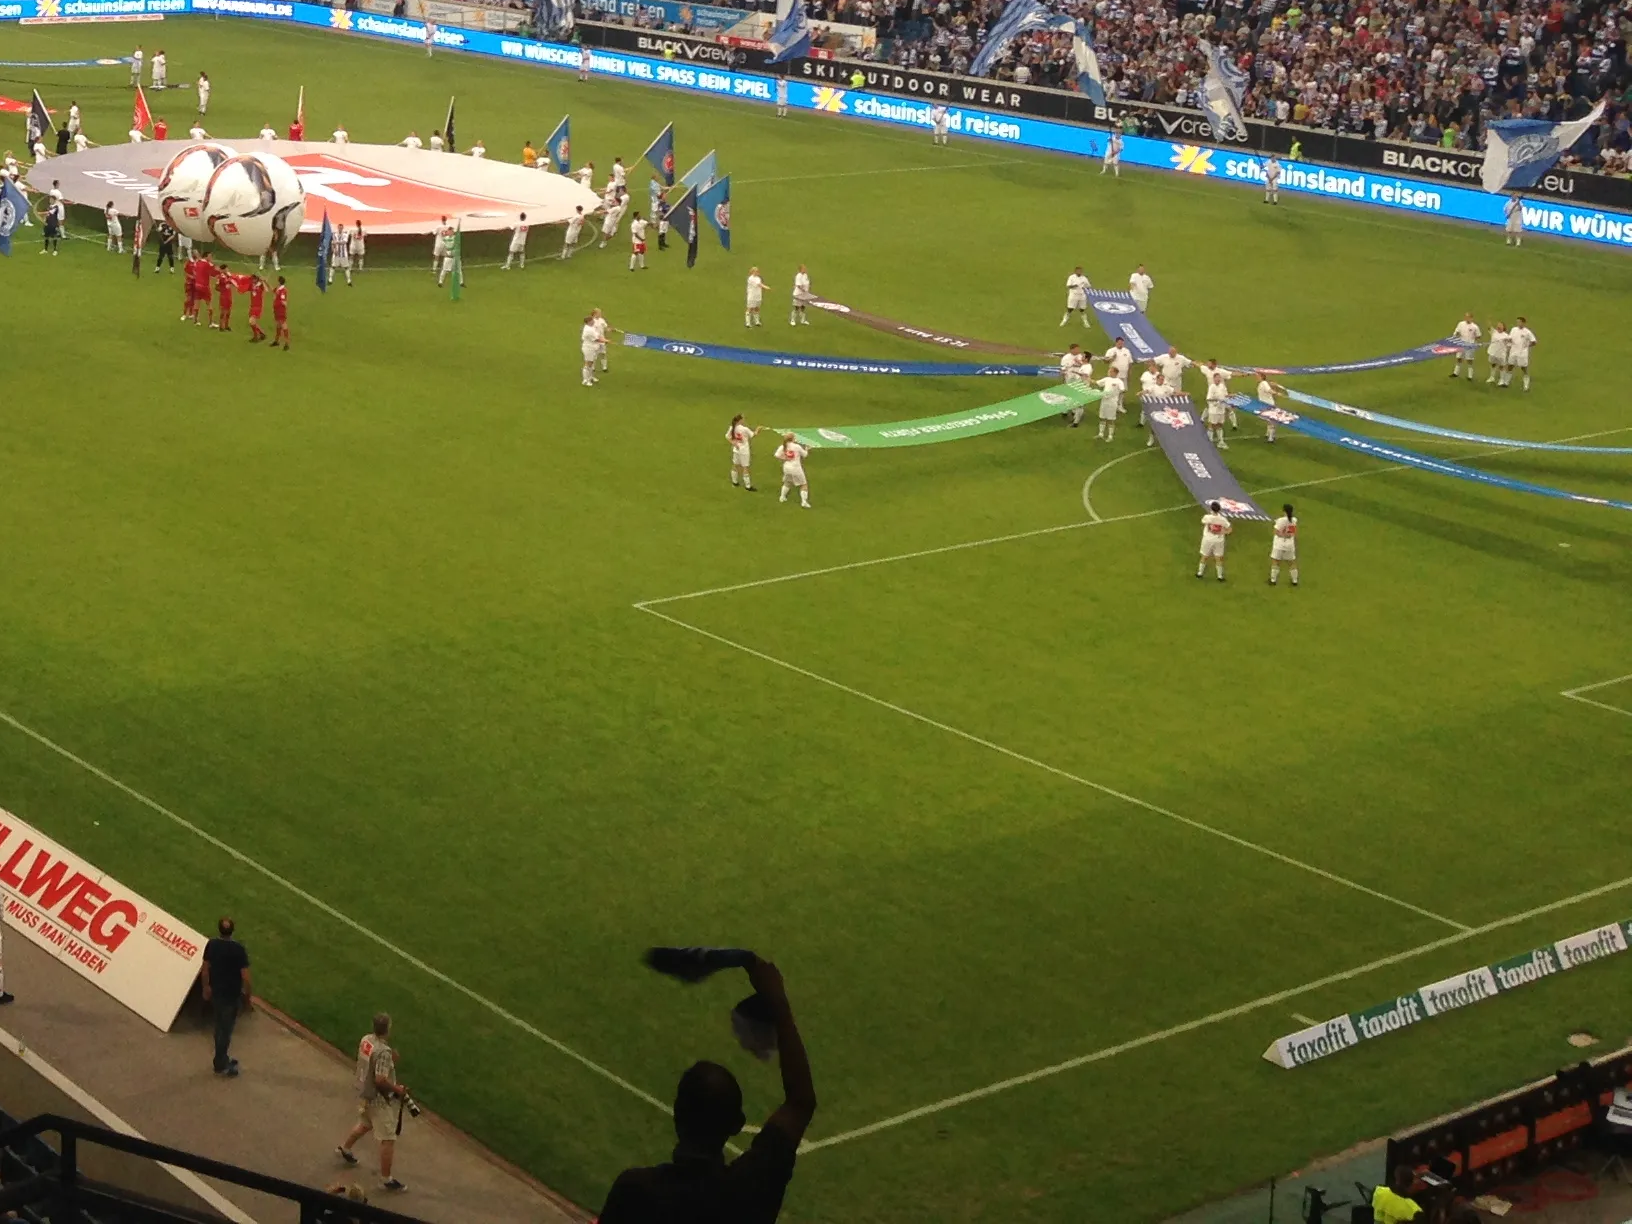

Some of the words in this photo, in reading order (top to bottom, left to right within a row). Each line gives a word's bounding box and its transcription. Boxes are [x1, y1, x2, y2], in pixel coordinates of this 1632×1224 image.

[638, 36, 682, 56] BLACK
[501, 41, 523, 56] WIR
[627, 60, 654, 78] VIEL
[657, 64, 695, 86] SPASS
[698, 71, 731, 91] BEIM
[734, 77, 771, 98] SPIEL
[803, 62, 835, 77] SKI
[868, 72, 950, 97] UTDOOR
[963, 86, 1021, 107] WEAR
[854, 96, 962, 130] schauinslnd
[966, 115, 1020, 140] reisen
[1371, 181, 1441, 210] reisen
[1521, 206, 1564, 231] WIR
[5, 899, 41, 929] MUSS
[38, 921, 68, 947] MAN
[64, 938, 109, 974] HABEN
[149, 921, 199, 958] HELLWEG
[1562, 929, 1620, 967] taxofit
[1498, 948, 1556, 990] taxofit
[1428, 973, 1492, 1013] taxofit
[1358, 995, 1422, 1039] taxofit
[1287, 1021, 1351, 1066] taxofit
